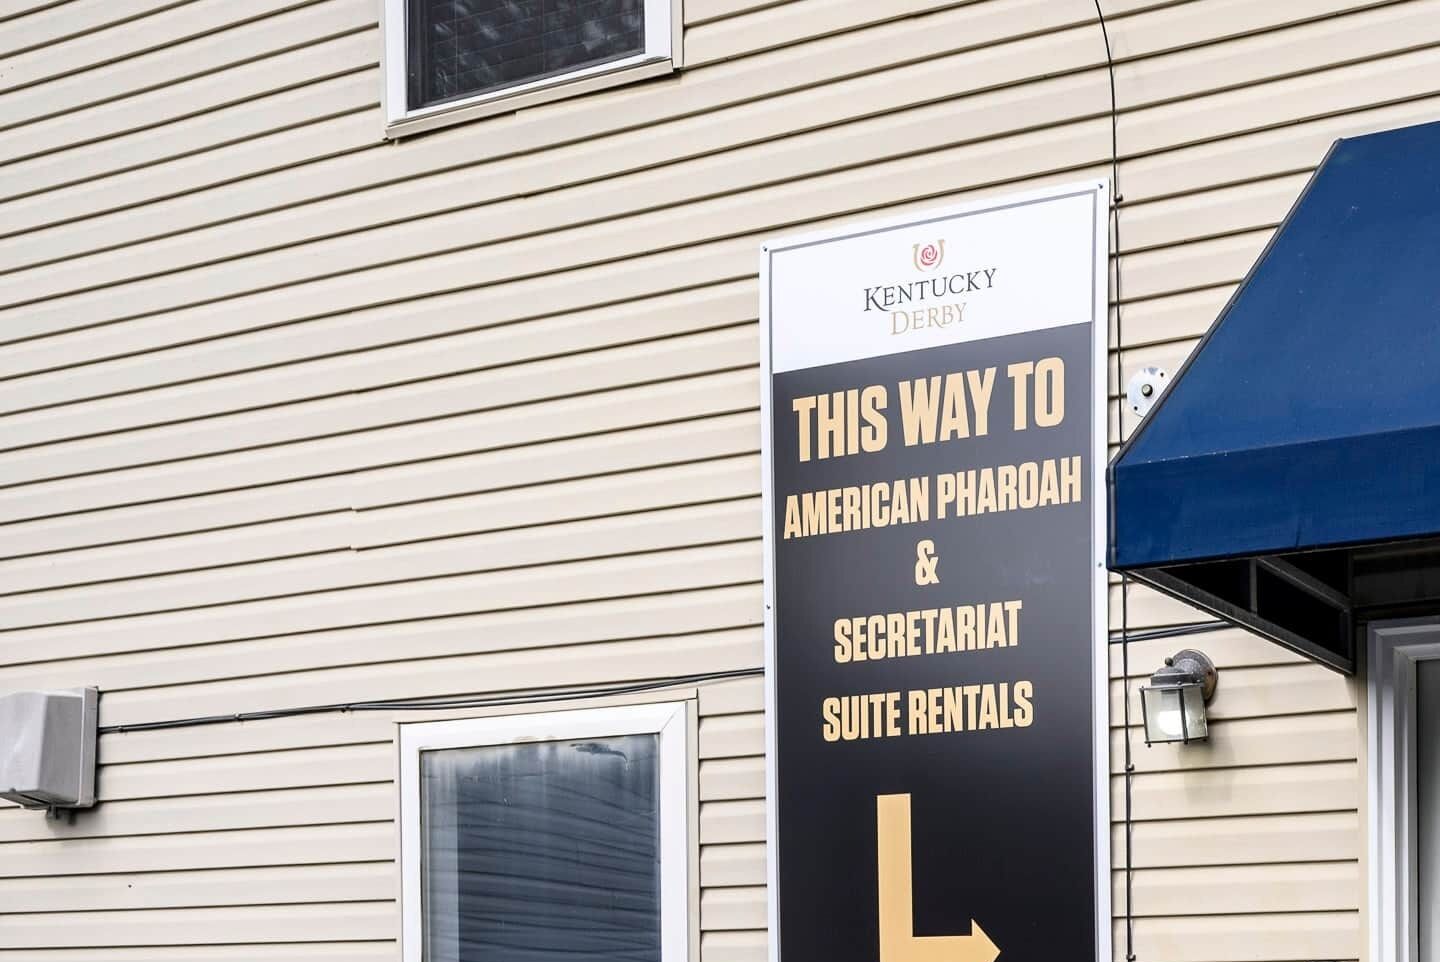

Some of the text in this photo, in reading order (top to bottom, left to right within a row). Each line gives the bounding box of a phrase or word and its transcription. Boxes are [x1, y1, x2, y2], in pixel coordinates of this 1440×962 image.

[863, 268, 997, 312] KENTUCKY
[891, 302, 968, 335] DERBY
[792, 356, 1065, 462] THIS WAY TO
[783, 456, 1082, 540] AMERICAN PHAROAH
[915, 539, 940, 586] &
[834, 600, 1023, 663] SECRETARIAT
[823, 680, 1034, 742] SUITE RENTALS
